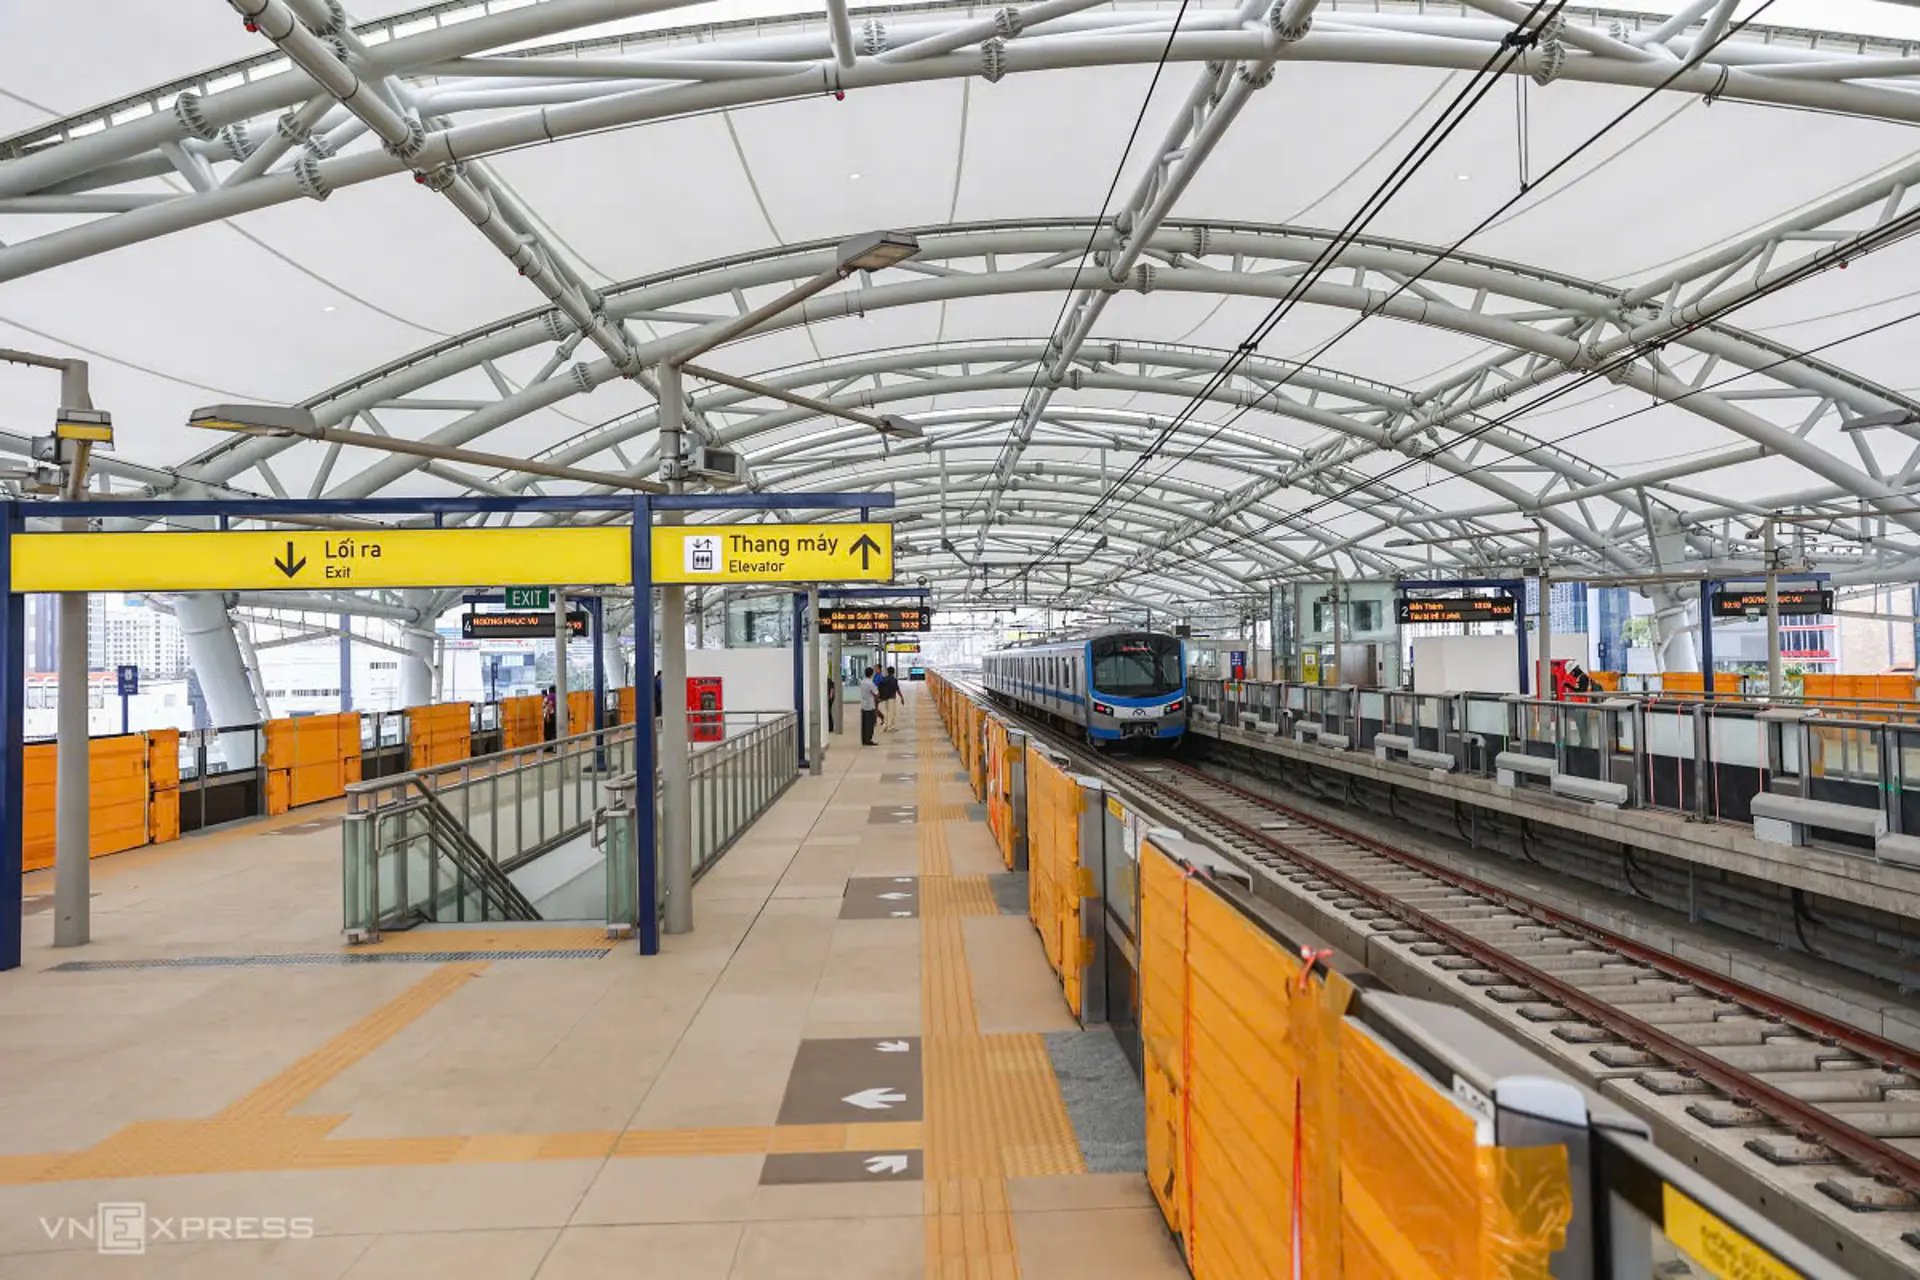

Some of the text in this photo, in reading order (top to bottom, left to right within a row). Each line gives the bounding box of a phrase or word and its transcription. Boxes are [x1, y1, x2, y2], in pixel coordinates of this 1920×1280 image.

[325, 538, 382, 558] Lối ra
[729, 533, 838, 556] Thang máy
[326, 566, 351, 578] Exit
[729, 560, 785, 573] Elevator
[512, 590, 541, 606] EXIT
[1825, 597, 1830, 608] 1
[1401, 606, 1409, 616] 2
[921, 614, 929, 625] 3
[464, 620, 472, 632] 4
